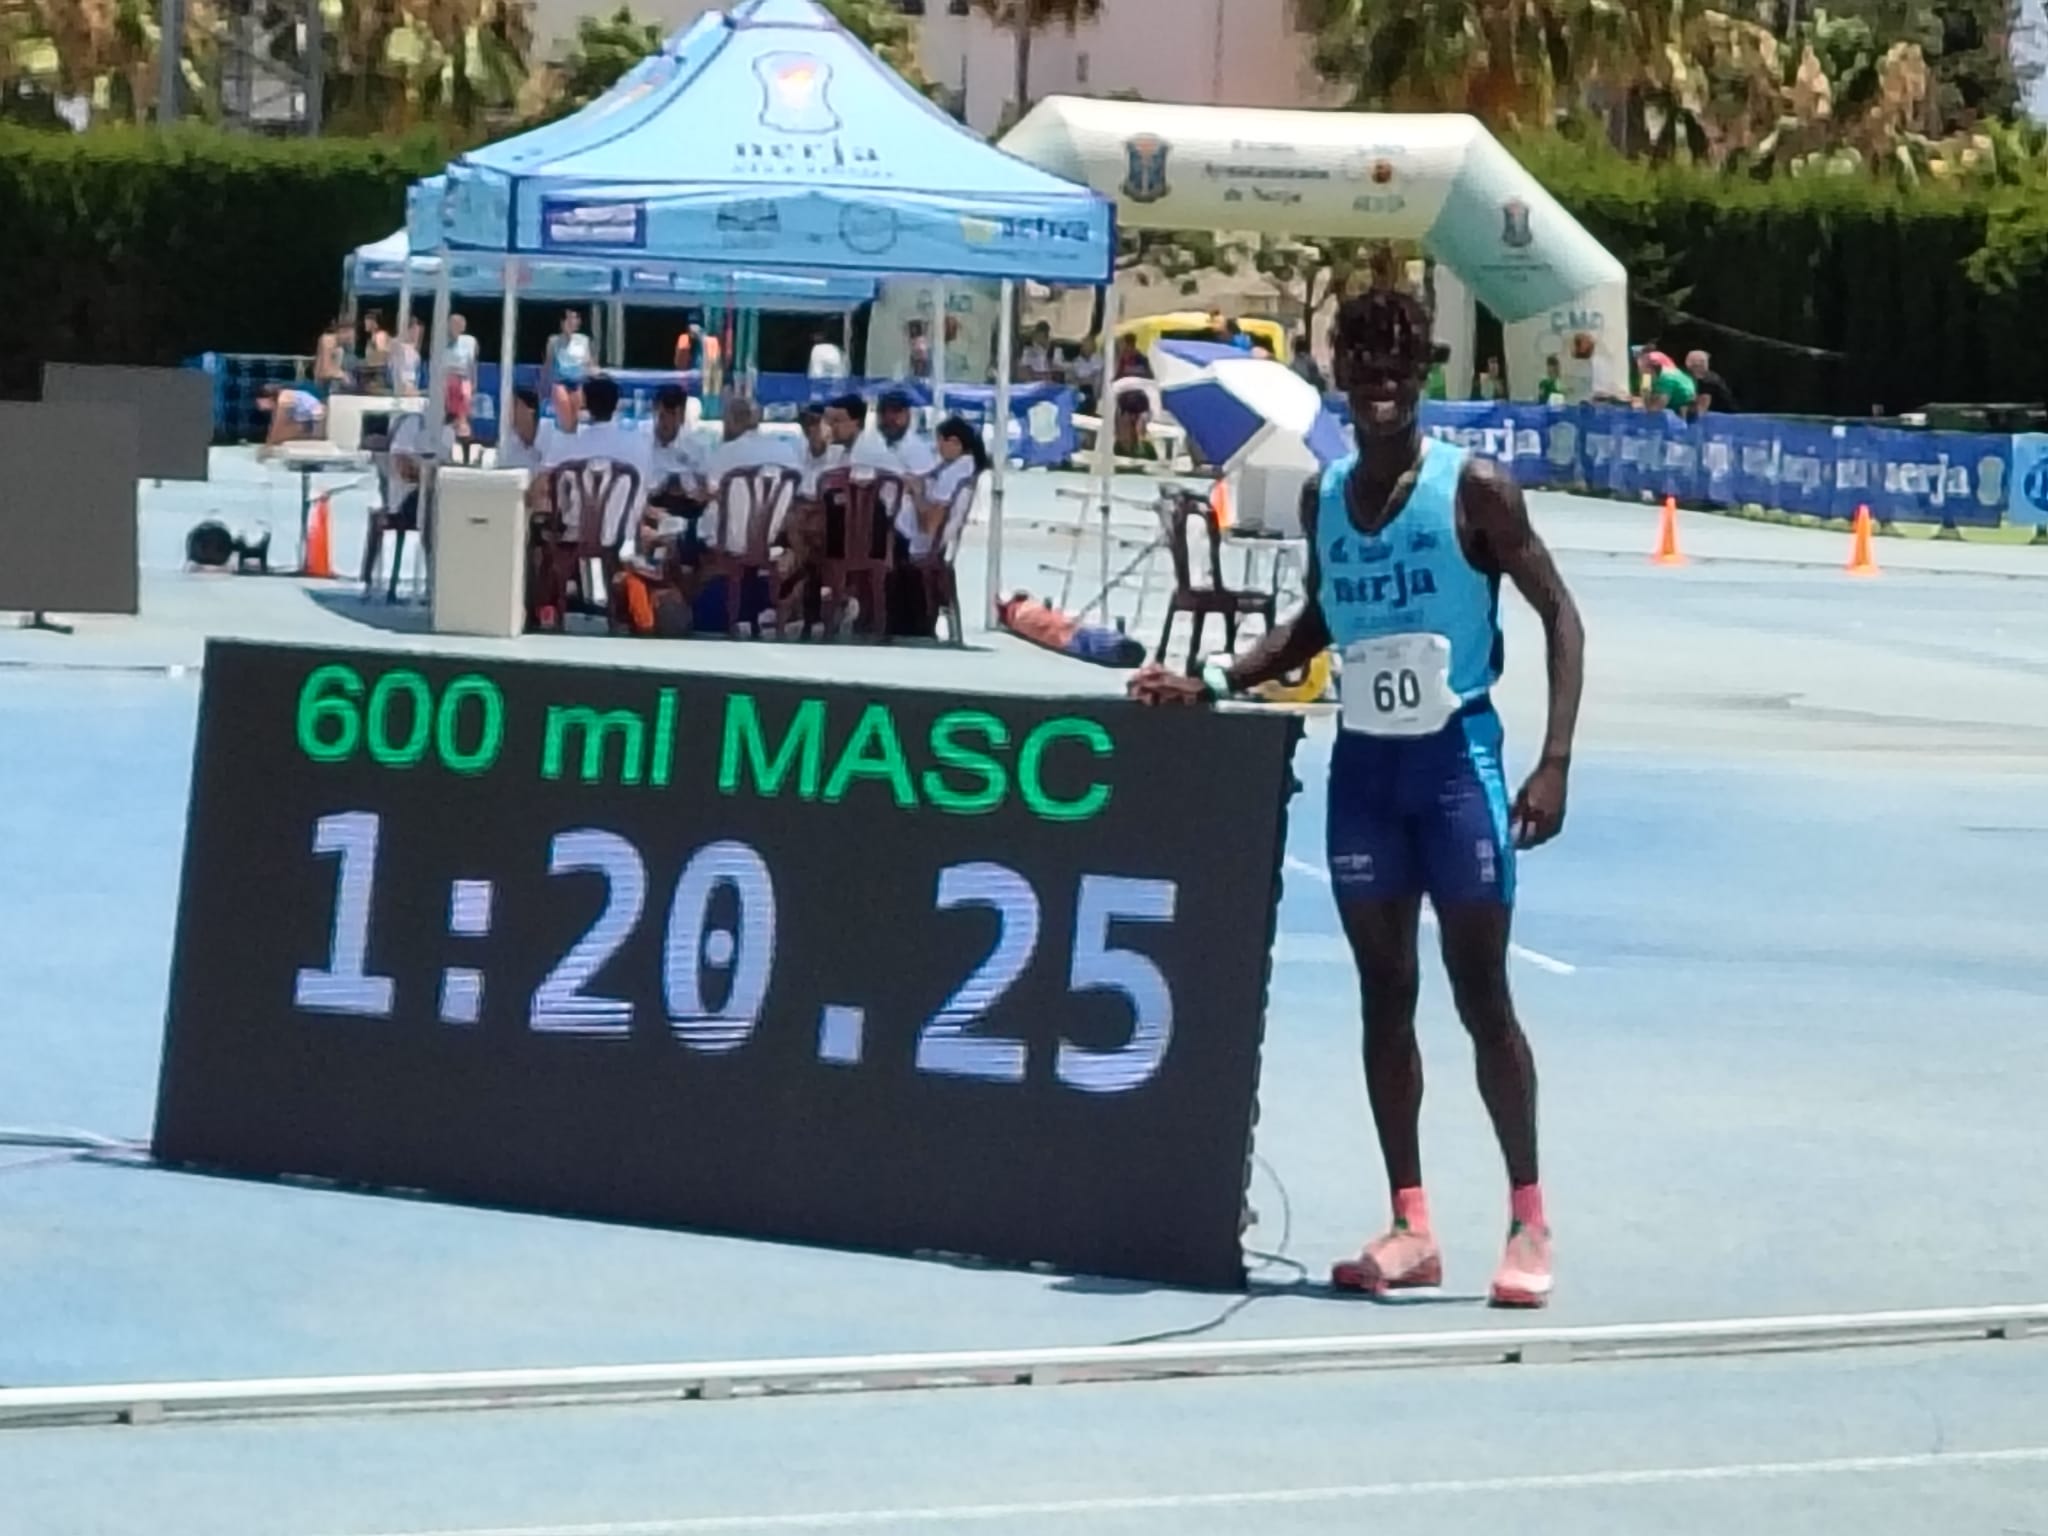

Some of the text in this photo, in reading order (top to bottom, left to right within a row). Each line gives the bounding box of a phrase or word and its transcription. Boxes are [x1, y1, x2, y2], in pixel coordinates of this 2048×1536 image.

[1373, 668, 1421, 713] 60
[296, 664, 1115, 822] 600 ml MASC
